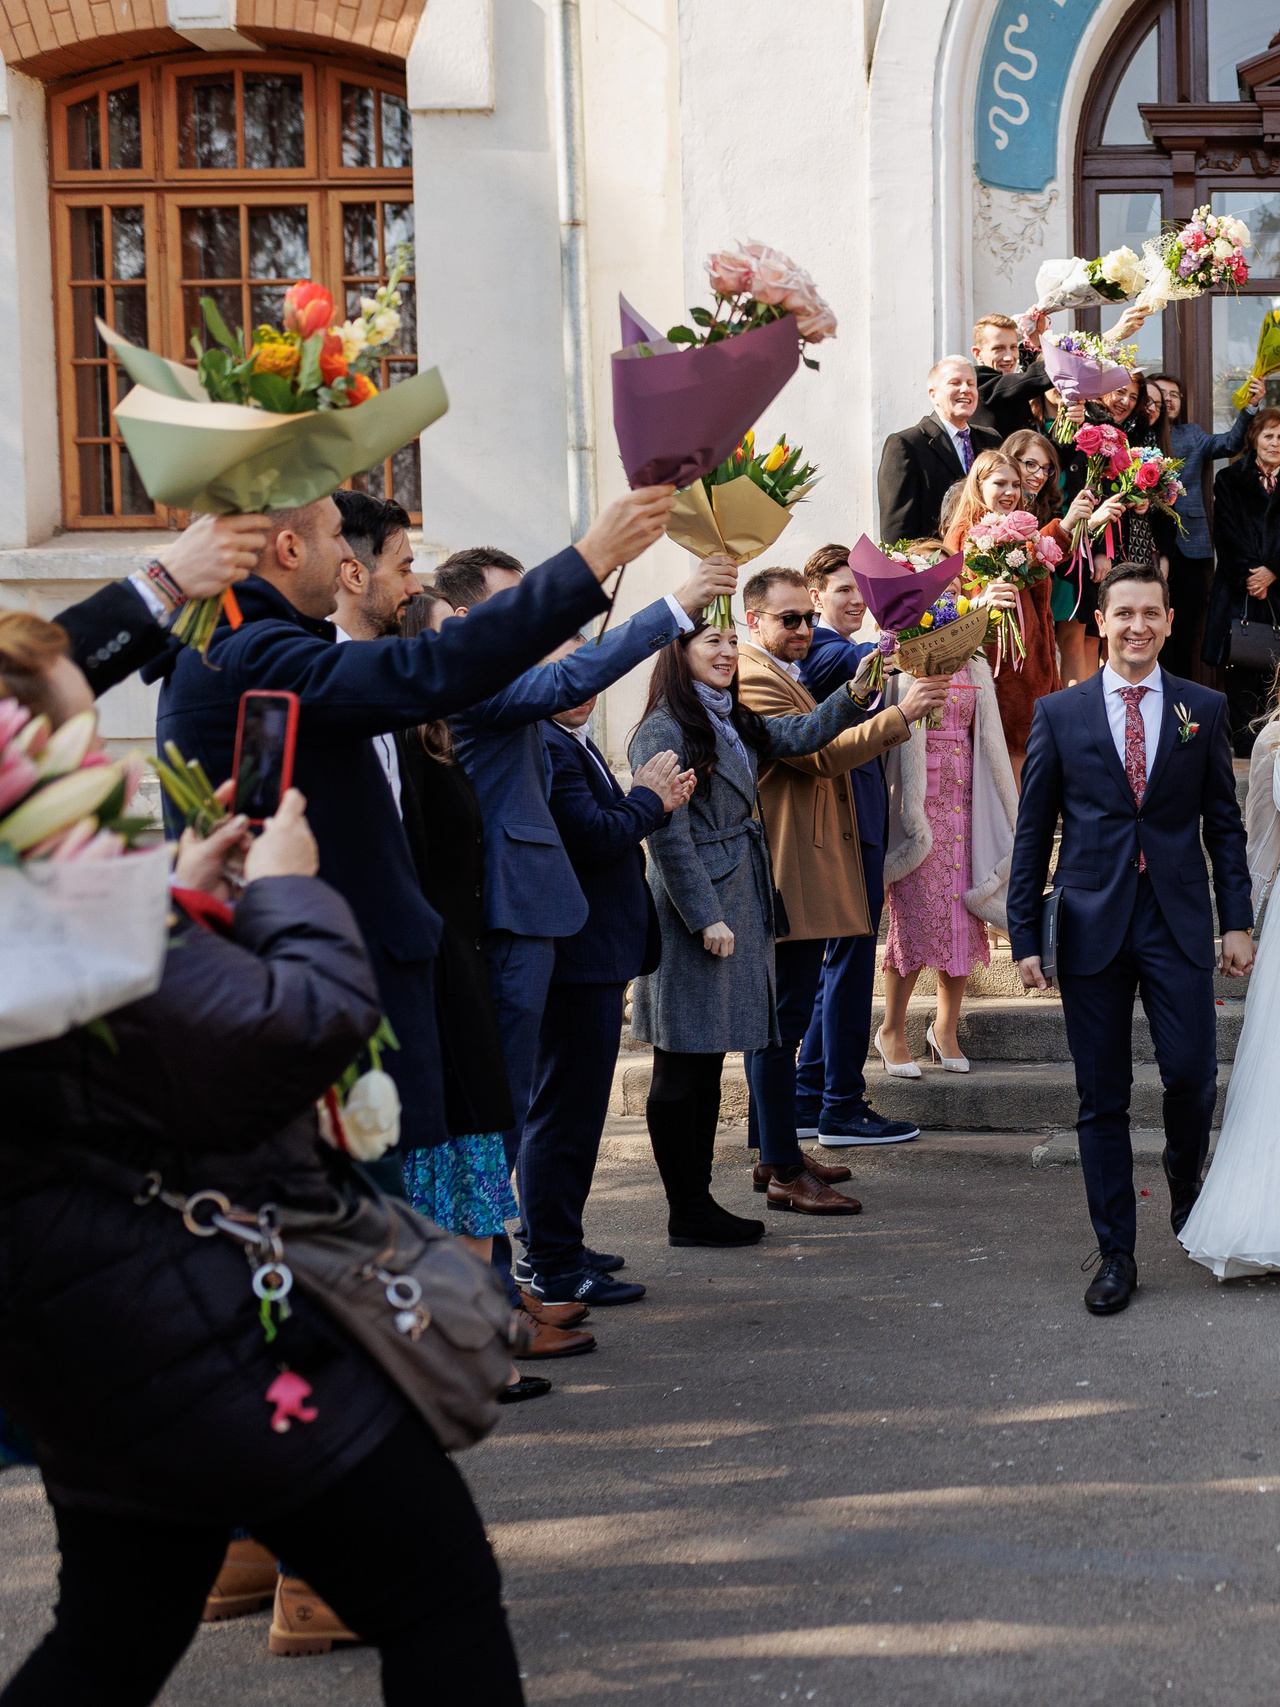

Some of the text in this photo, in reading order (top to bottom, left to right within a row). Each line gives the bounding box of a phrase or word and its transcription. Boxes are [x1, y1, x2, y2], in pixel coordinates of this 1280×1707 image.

[920, 636, 945, 651] Zero
[950, 616, 980, 637] Start
[574, 1279, 593, 1299] BOSS
